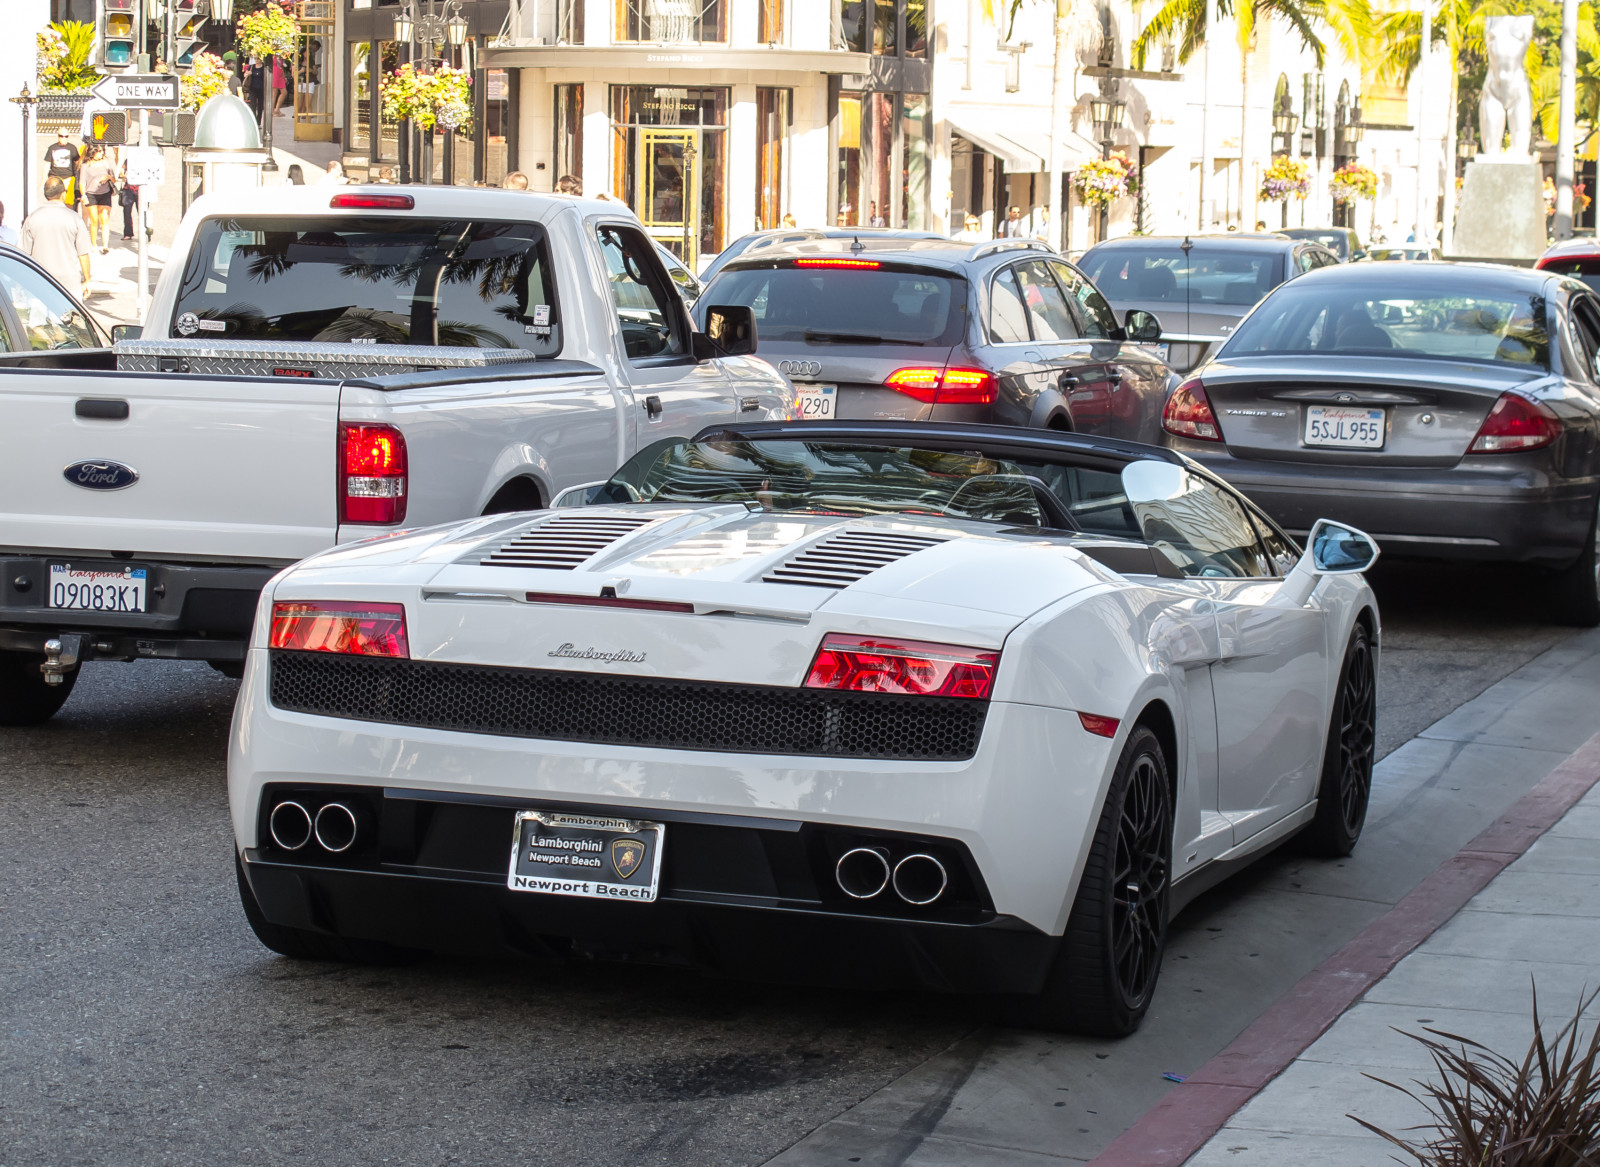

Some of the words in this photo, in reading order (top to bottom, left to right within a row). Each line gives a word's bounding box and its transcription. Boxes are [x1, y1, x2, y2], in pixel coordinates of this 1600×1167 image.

[117, 85, 141, 97] ONE
[145, 85, 169, 97] WAY
[643, 102, 674, 110] STEFANO
[676, 103, 696, 111] RICCI
[1225, 408, 1268, 417] TAURUS
[1323, 408, 1370, 421] California
[1312, 420, 1377, 440] 5SJL955
[78, 464, 118, 483] Ford
[54, 582, 141, 612] 09083K1
[547, 643, 646, 663] Lamborghini
[551, 814, 630, 828] Lamborghini
[531, 835, 602, 851] Lamborghini
[529, 852, 569, 864] Newport
[571, 856, 601, 867] Beach
[514, 876, 589, 893] Newport
[596, 884, 651, 899] Beach
